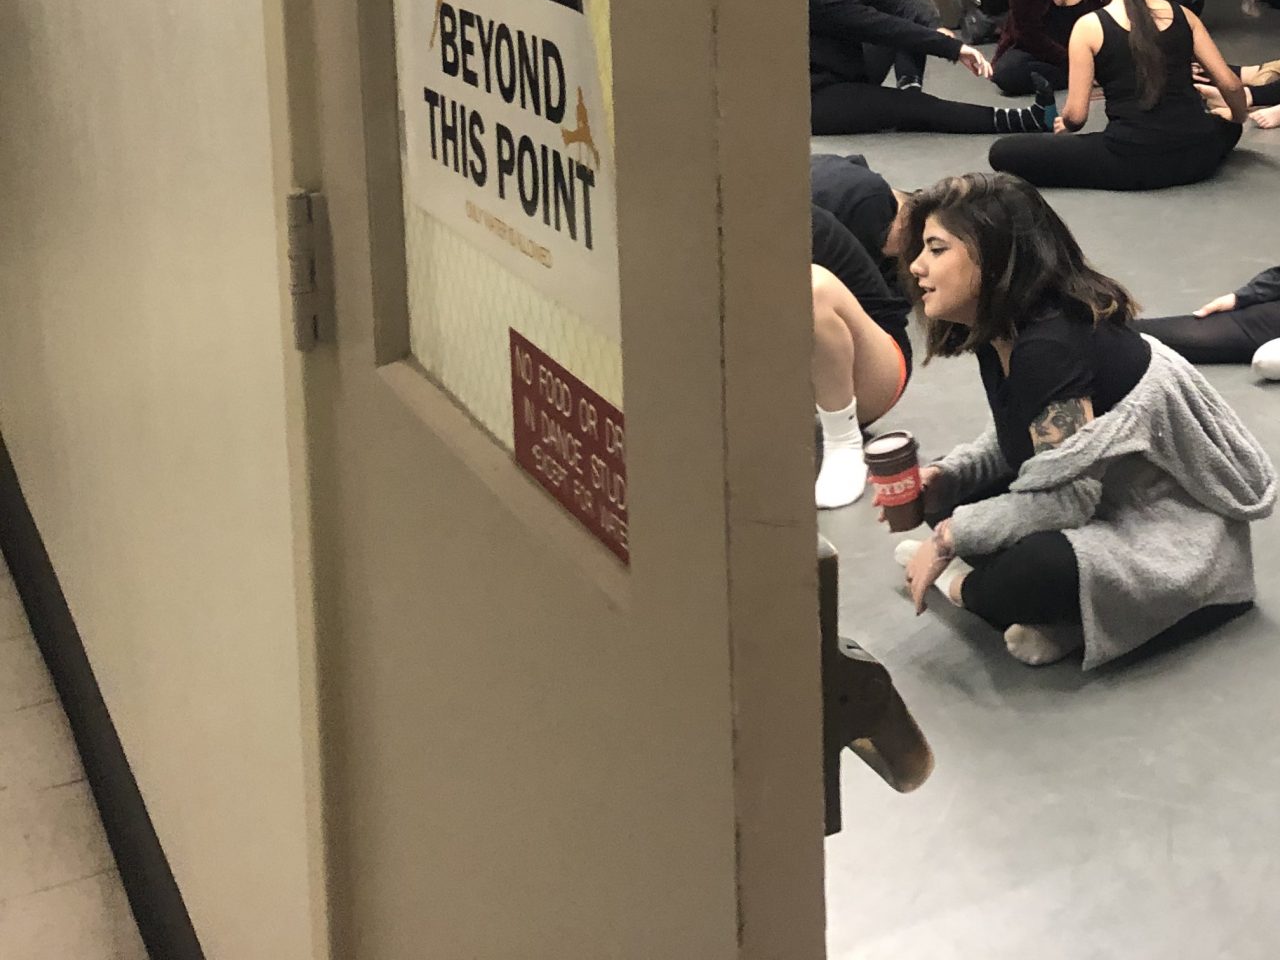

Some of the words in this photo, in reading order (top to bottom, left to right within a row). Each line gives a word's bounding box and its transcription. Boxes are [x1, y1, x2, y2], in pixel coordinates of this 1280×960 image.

[439, 1, 567, 124] BEYOND
[424, 86, 488, 188] THIS
[496, 122, 596, 251] POINT
[515, 344, 533, 386] NO
[538, 363, 572, 418] FOOD
[579, 397, 598, 441] OR
[591, 453, 626, 511] STUD
